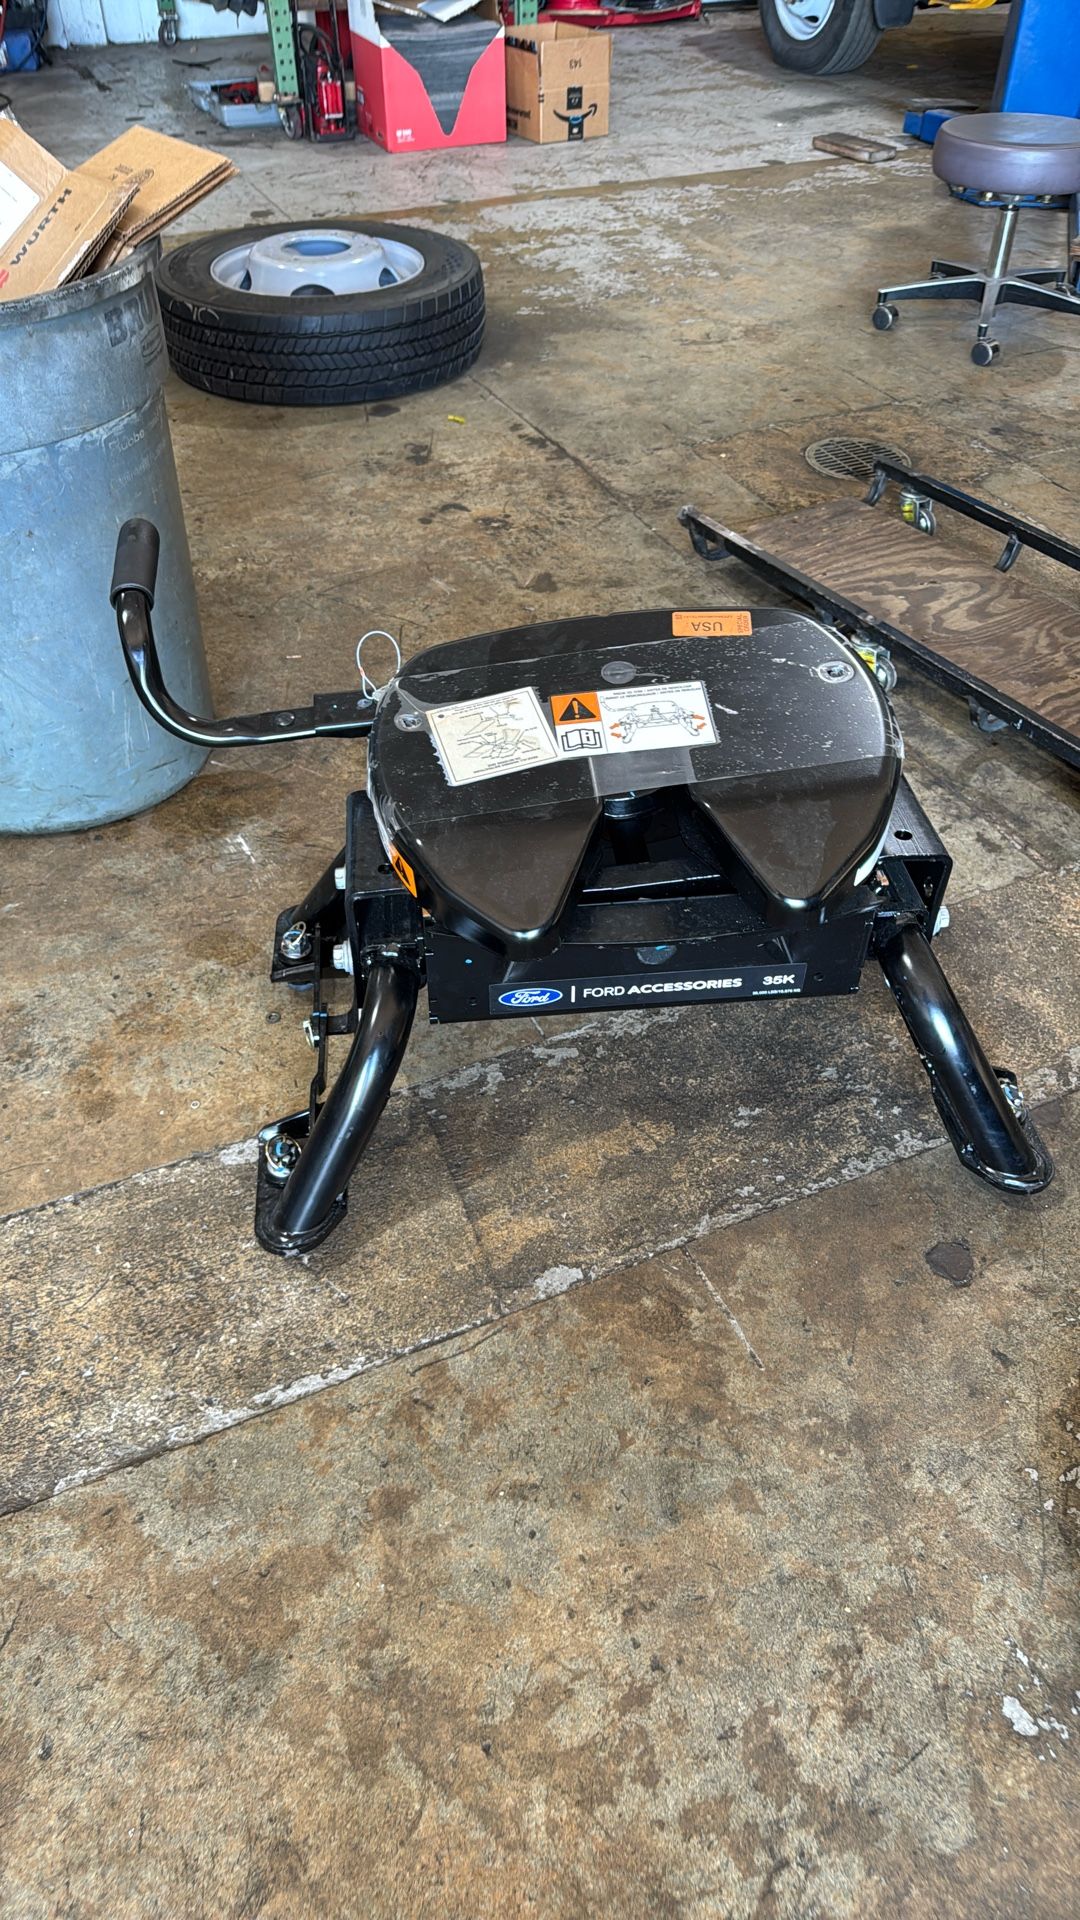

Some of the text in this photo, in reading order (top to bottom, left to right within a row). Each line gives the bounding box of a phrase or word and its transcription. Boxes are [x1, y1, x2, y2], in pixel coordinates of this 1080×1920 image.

[691, 621, 723, 632] USA
[763, 974, 795, 986] 35K
[583, 985, 625, 998] FORD
[627, 978, 743, 995] ACCESSORIES
[509, 989, 551, 1005] Ford
